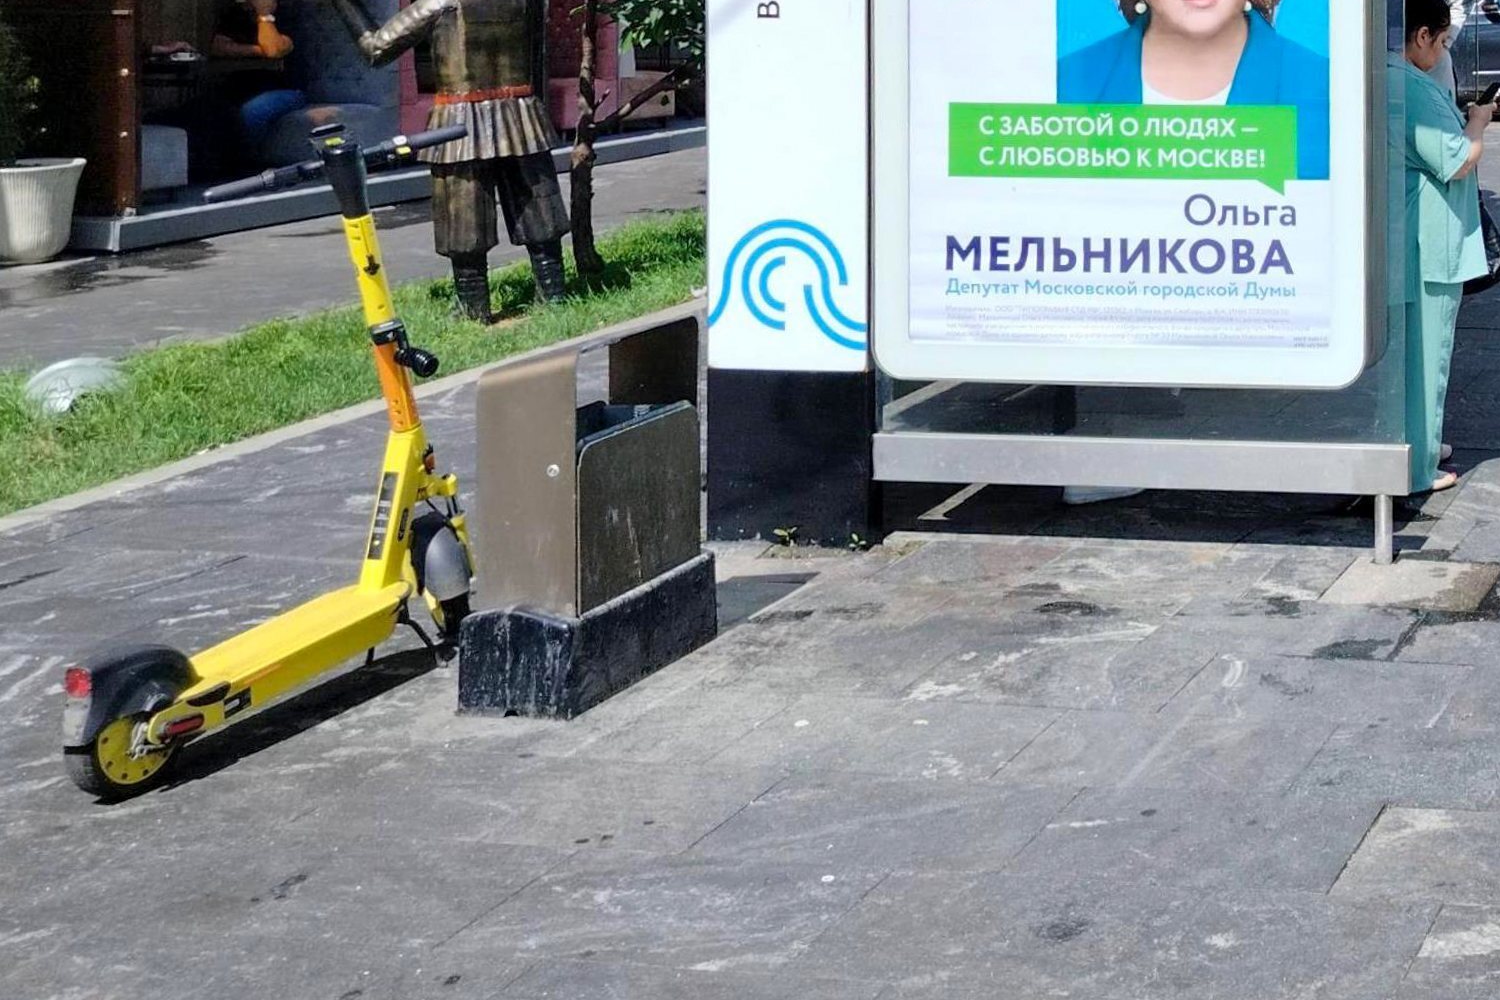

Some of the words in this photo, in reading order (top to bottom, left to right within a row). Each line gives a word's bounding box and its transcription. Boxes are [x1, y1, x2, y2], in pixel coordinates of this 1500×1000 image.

[979, 115, 995, 136] С
[1000, 113, 1114, 137] ЗАБОТОЙ
[1119, 117, 1139, 137] О
[1143, 118, 1236, 141] ЛЮДЯХ
[979, 146, 995, 166] С
[1000, 147, 1131, 168] ЛЮБОВЬЮ
[1136, 148, 1152, 168] К
[1157, 148, 1266, 169] МОСКВЕ!
[1183, 193, 1297, 227] Ольга
[945, 235, 1295, 275] МЕЛЬНИКОВА
[945, 277, 1019, 297] Депутат
[1024, 279, 1138, 296] Московской
[1143, 282, 1239, 299] городской
[1243, 280, 1297, 299] Думы
